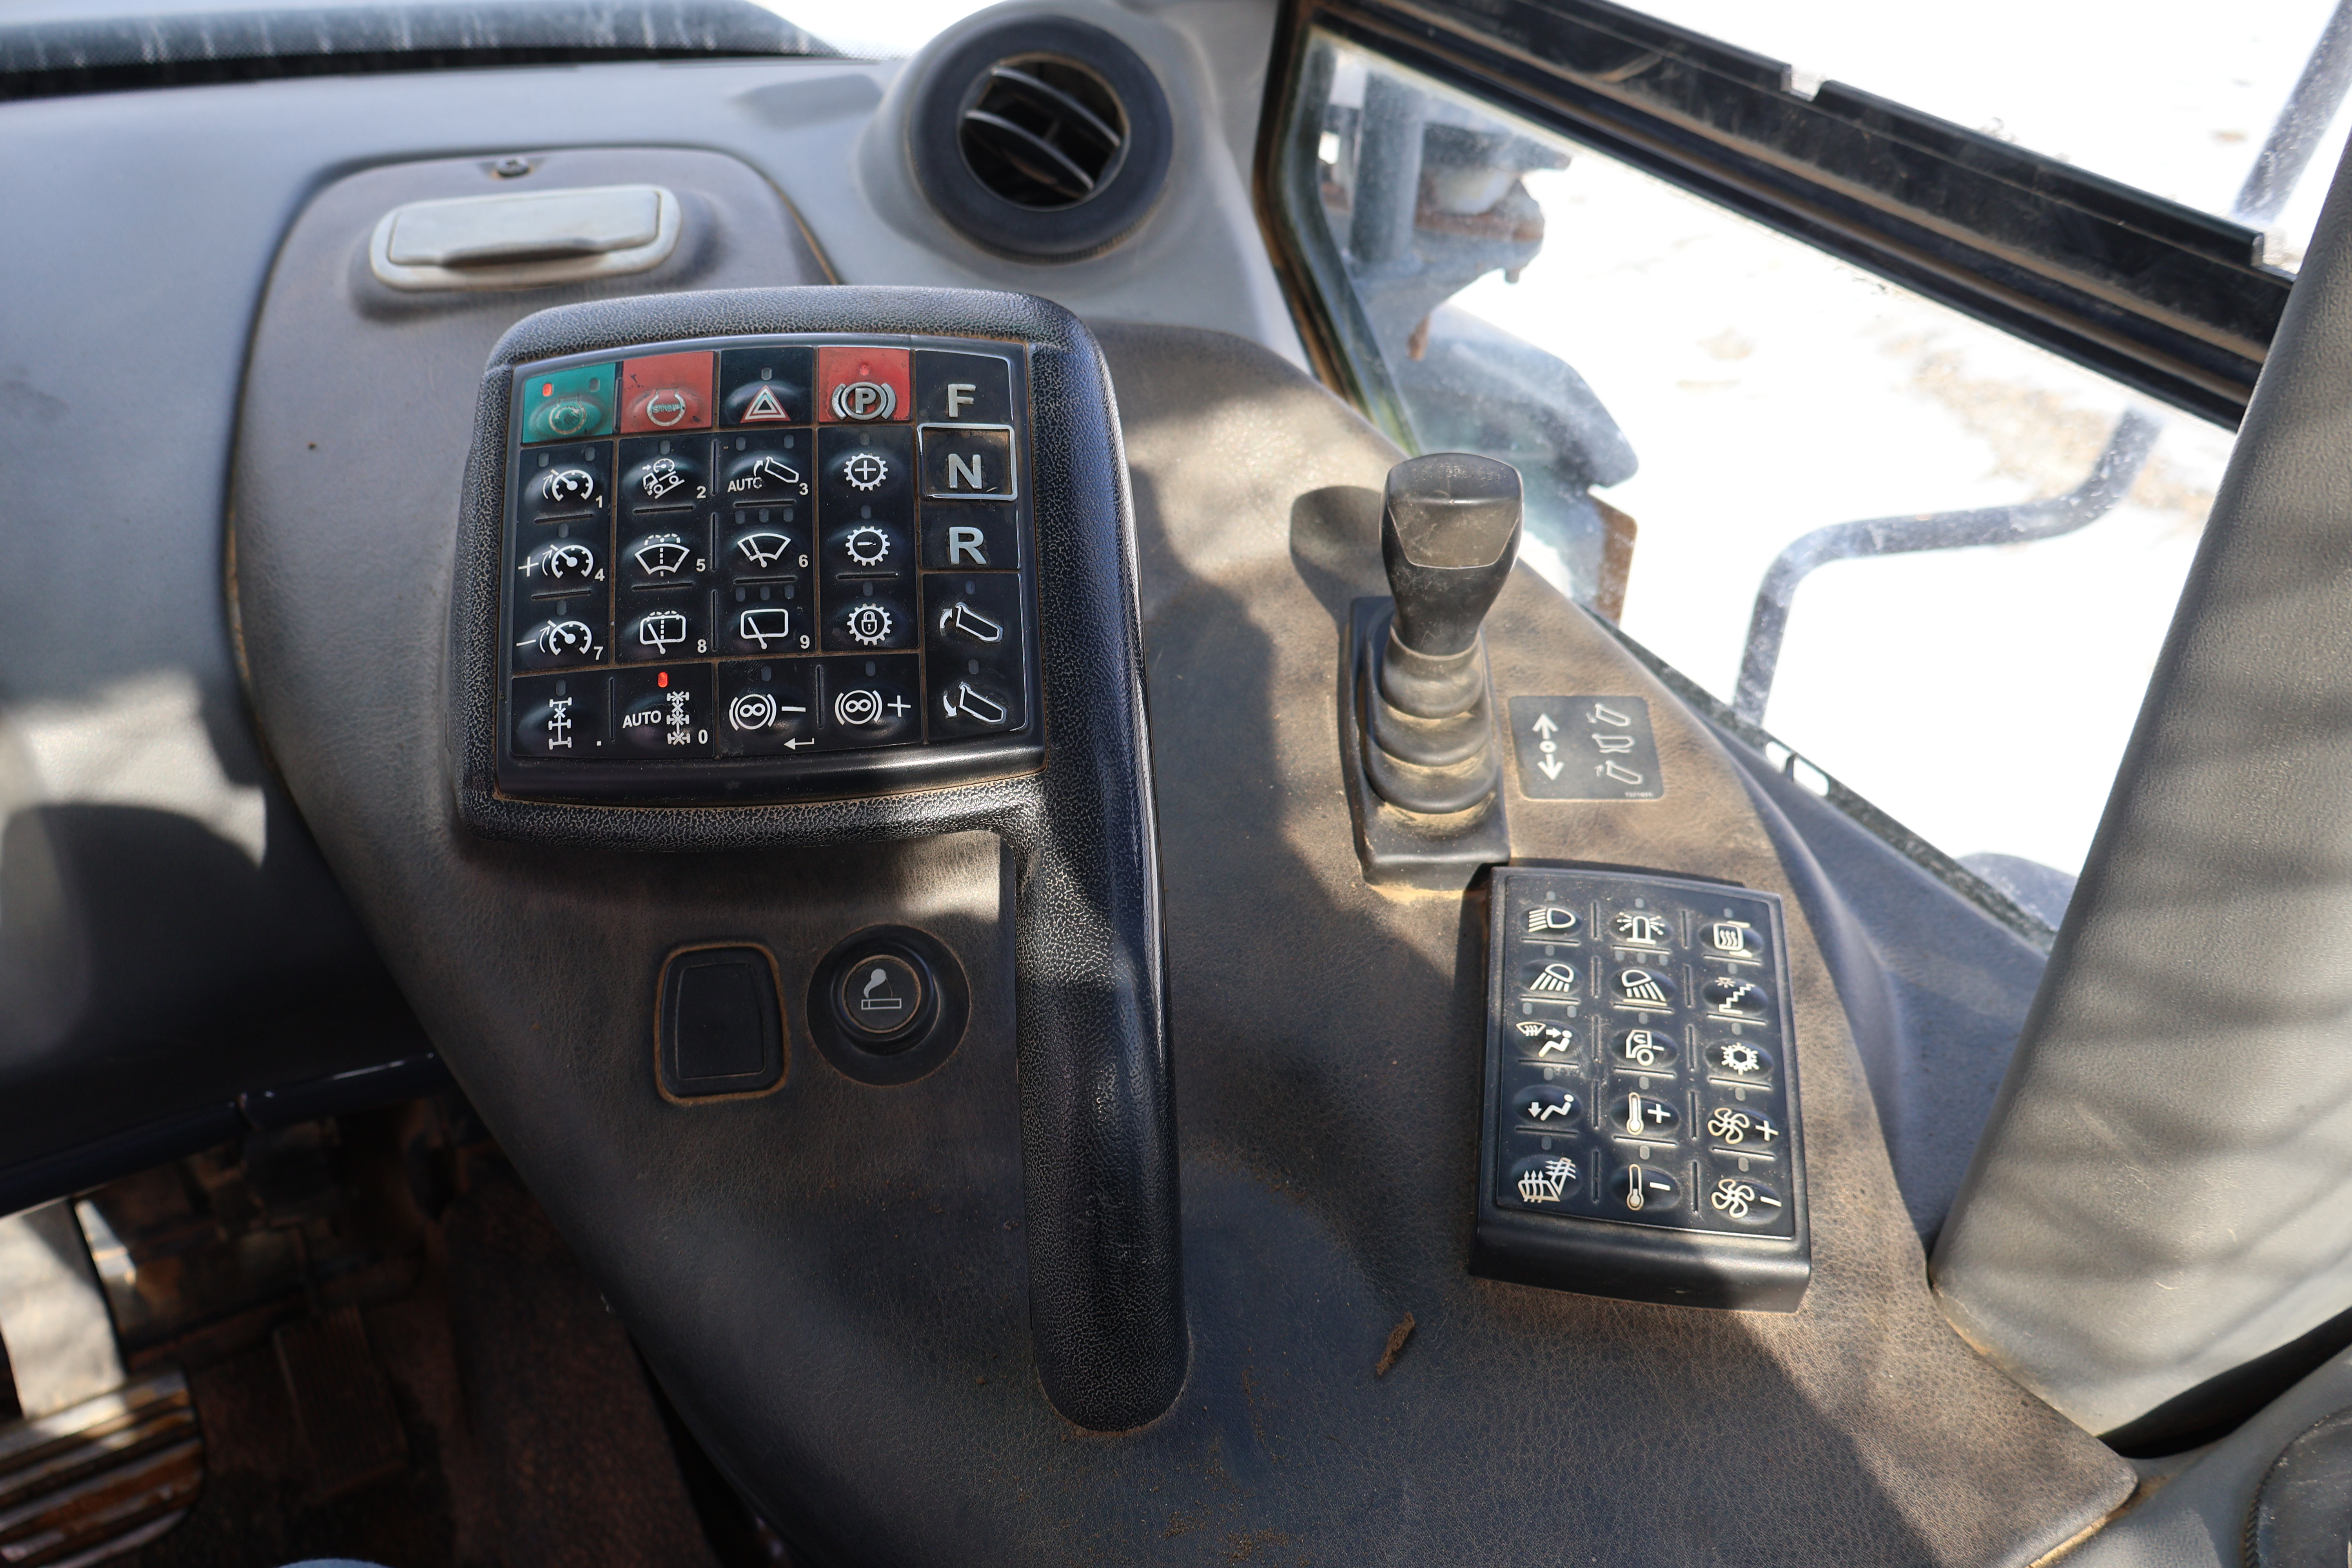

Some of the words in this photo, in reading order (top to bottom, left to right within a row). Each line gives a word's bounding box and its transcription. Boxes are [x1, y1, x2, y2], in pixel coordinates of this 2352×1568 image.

[855, 387, 877, 414] P
[947, 383, 976, 417] F
[652, 403, 679, 413] STOP
[948, 453, 982, 489] N
[697, 486, 706, 499] 2
[799, 483, 809, 495] 3
[595, 495, 603, 508] 1
[949, 526, 987, 564] R
[696, 559, 706, 572] 5
[799, 554, 808, 568] 6
[594, 568, 605, 581] 4
[697, 639, 707, 653] 8
[800, 635, 810, 649] 9
[593, 646, 603, 660] 7
[622, 710, 661, 729] AUTO
[698, 729, 708, 744] 0
